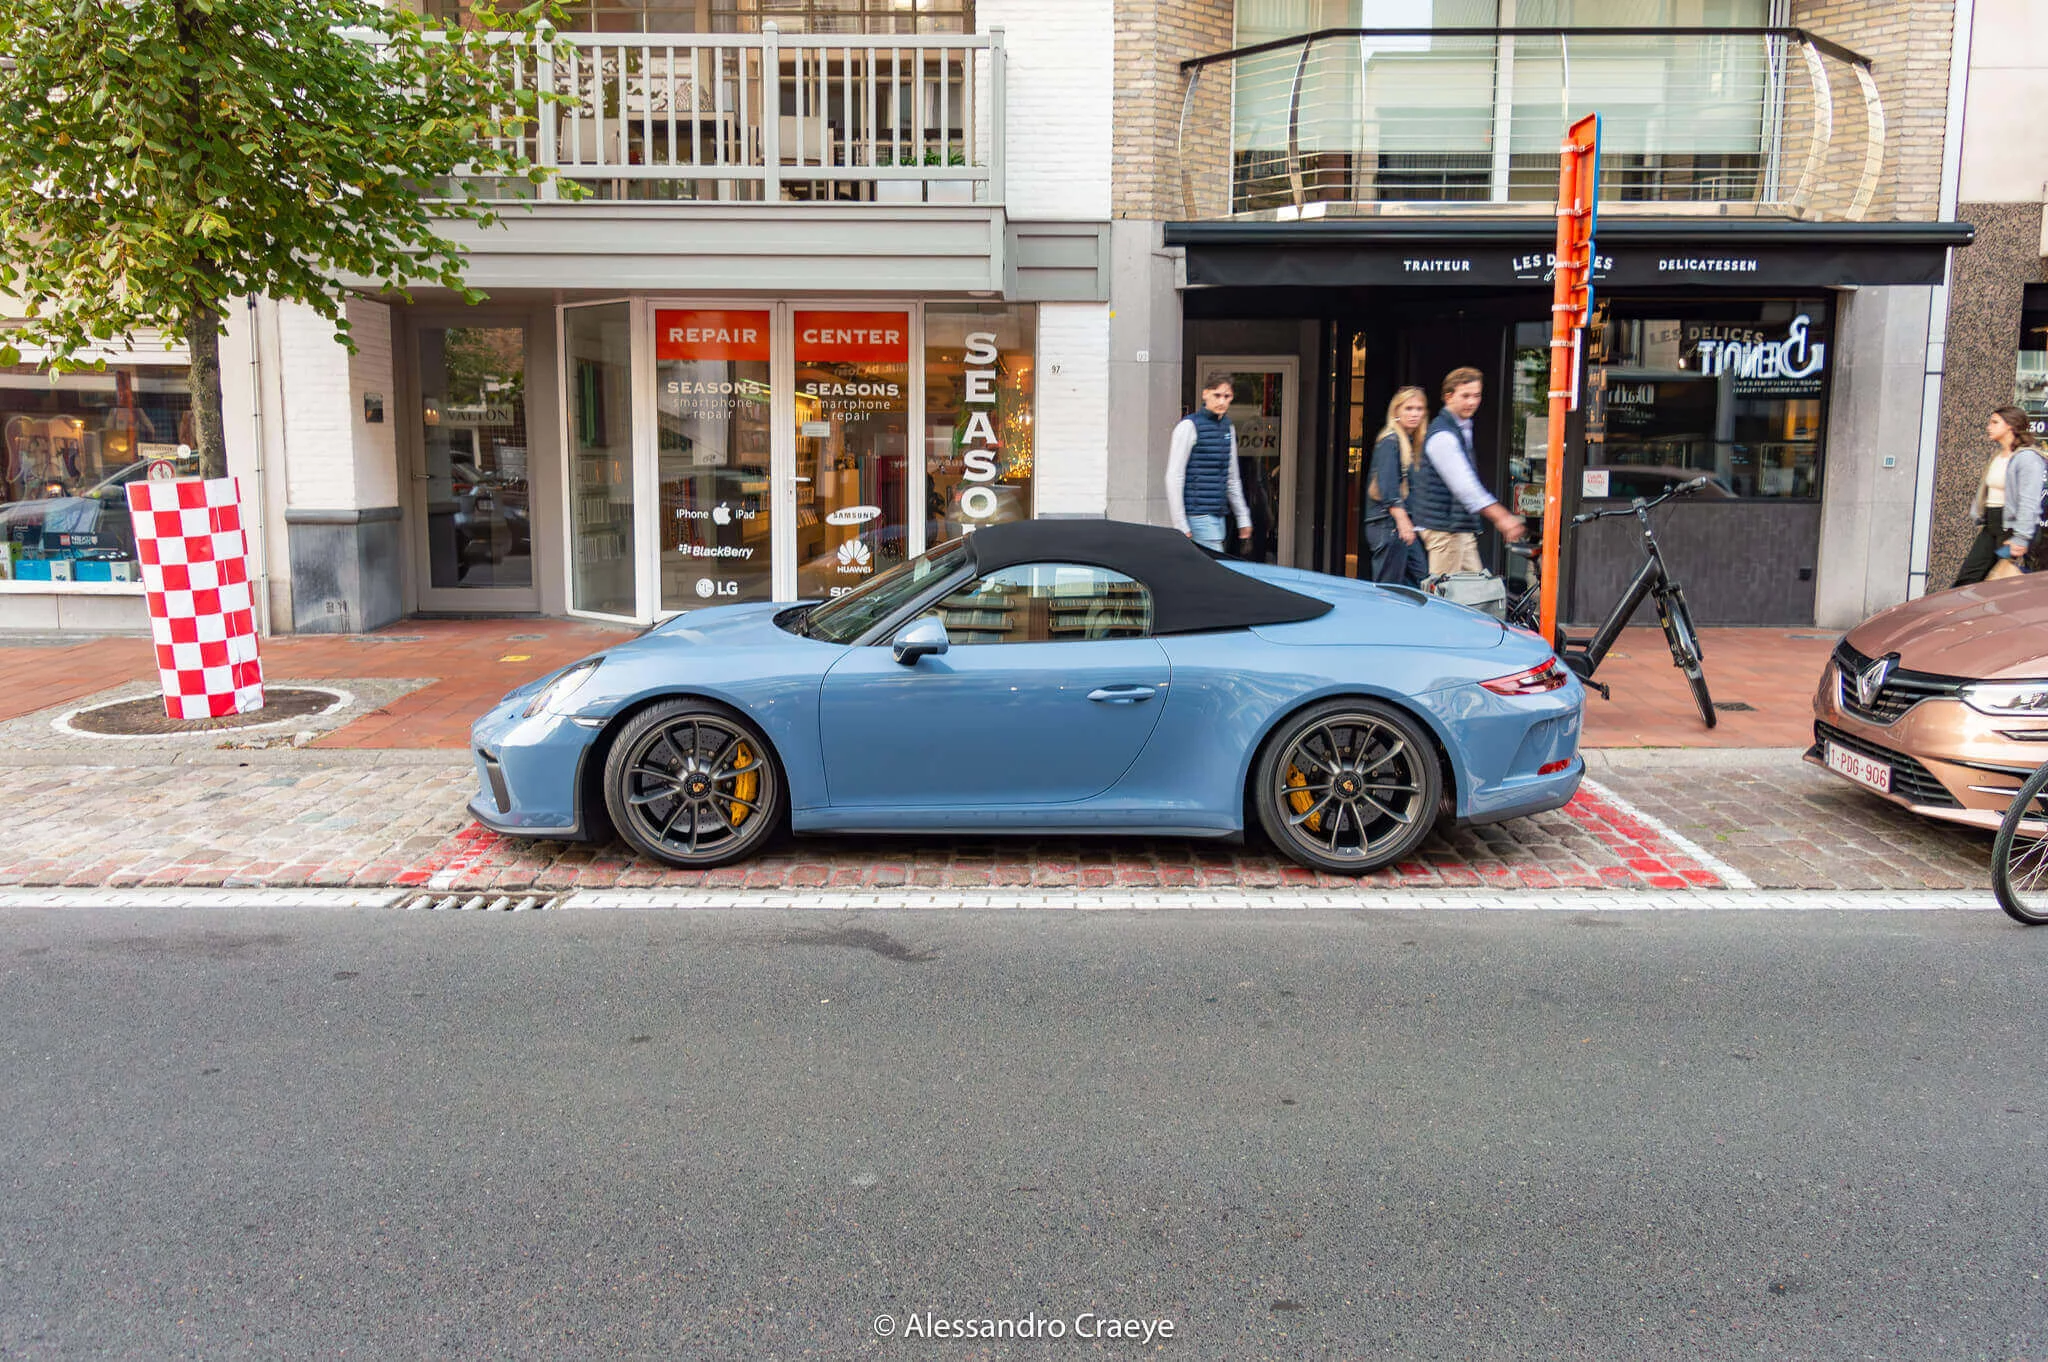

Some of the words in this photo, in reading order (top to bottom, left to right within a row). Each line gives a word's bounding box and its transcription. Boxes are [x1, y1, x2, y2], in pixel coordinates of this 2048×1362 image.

[1403, 260, 1470, 271] TRAITEUR
[1513, 254, 1541, 271] LES
[1658, 259, 1757, 271] DELICATESSEN
[669, 327, 757, 343] REPAIR
[803, 328, 900, 344] CENTER
[667, 382, 760, 394] SEASONS
[805, 382, 900, 396] SEASONS
[674, 395, 752, 409] smartphone
[811, 398, 891, 411] smartphone
[693, 407, 733, 420] repair
[832, 410, 870, 422] repair
[676, 509, 709, 519] iPhone
[735, 509, 755, 520] iPad
[692, 545, 754, 560] BlackBerry
[837, 565, 871, 574] HUAWEI
[717, 581, 738, 595] LG
[1830, 748, 1887, 788] 1-PDG-906
